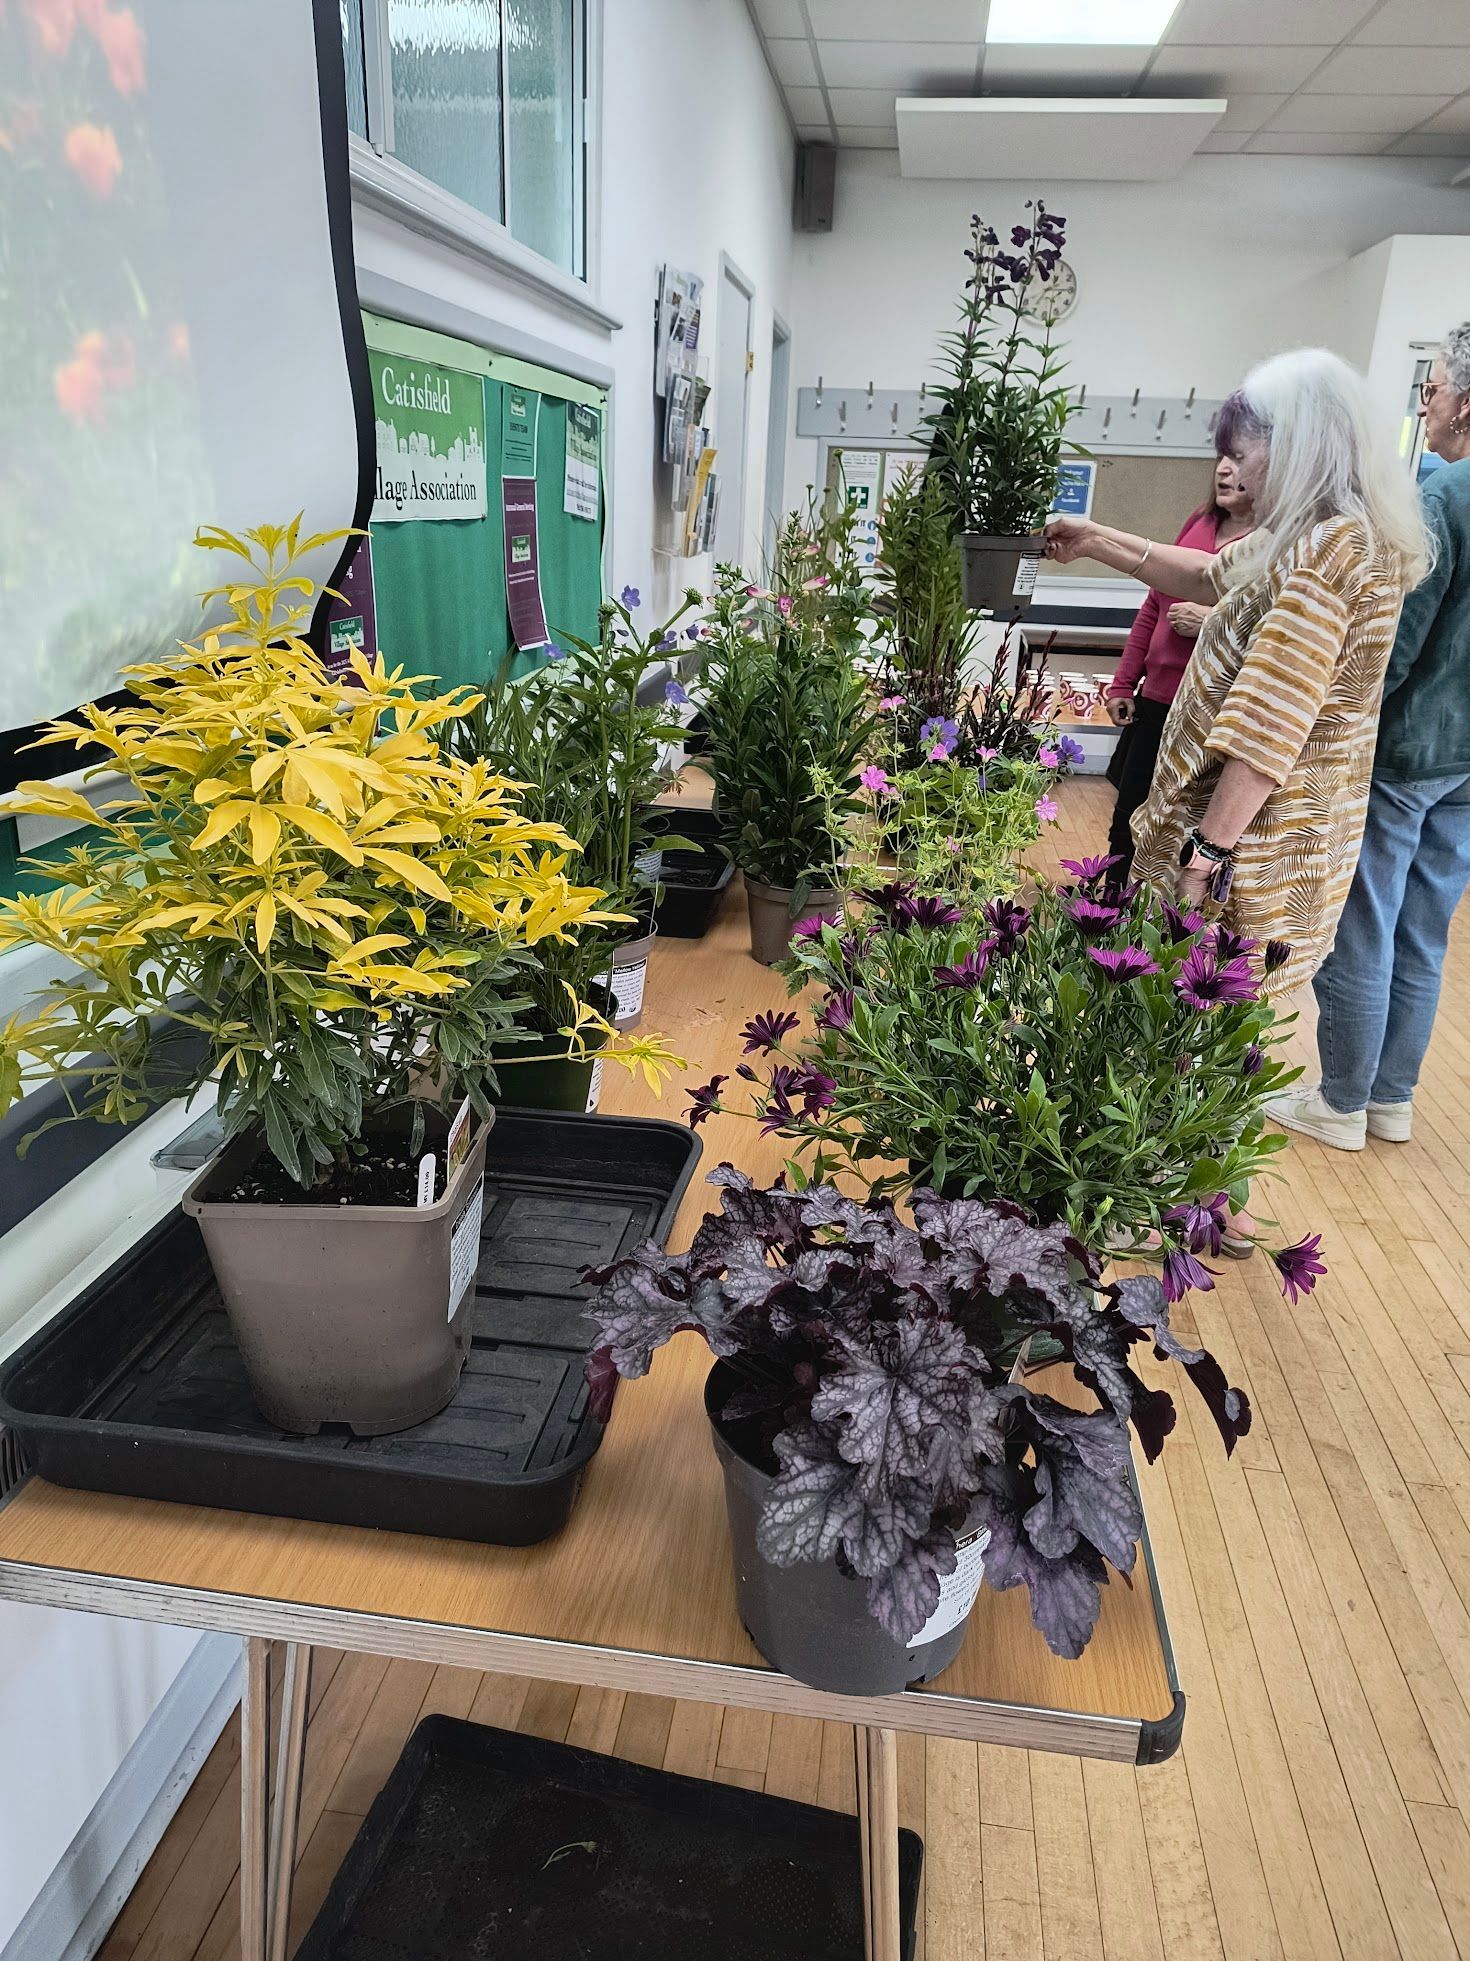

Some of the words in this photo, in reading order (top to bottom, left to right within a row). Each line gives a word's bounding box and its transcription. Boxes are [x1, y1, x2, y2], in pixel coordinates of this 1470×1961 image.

[381, 366, 452, 415] Catisfield
[375, 466, 408, 511] lage
[409, 469, 477, 501] Association
